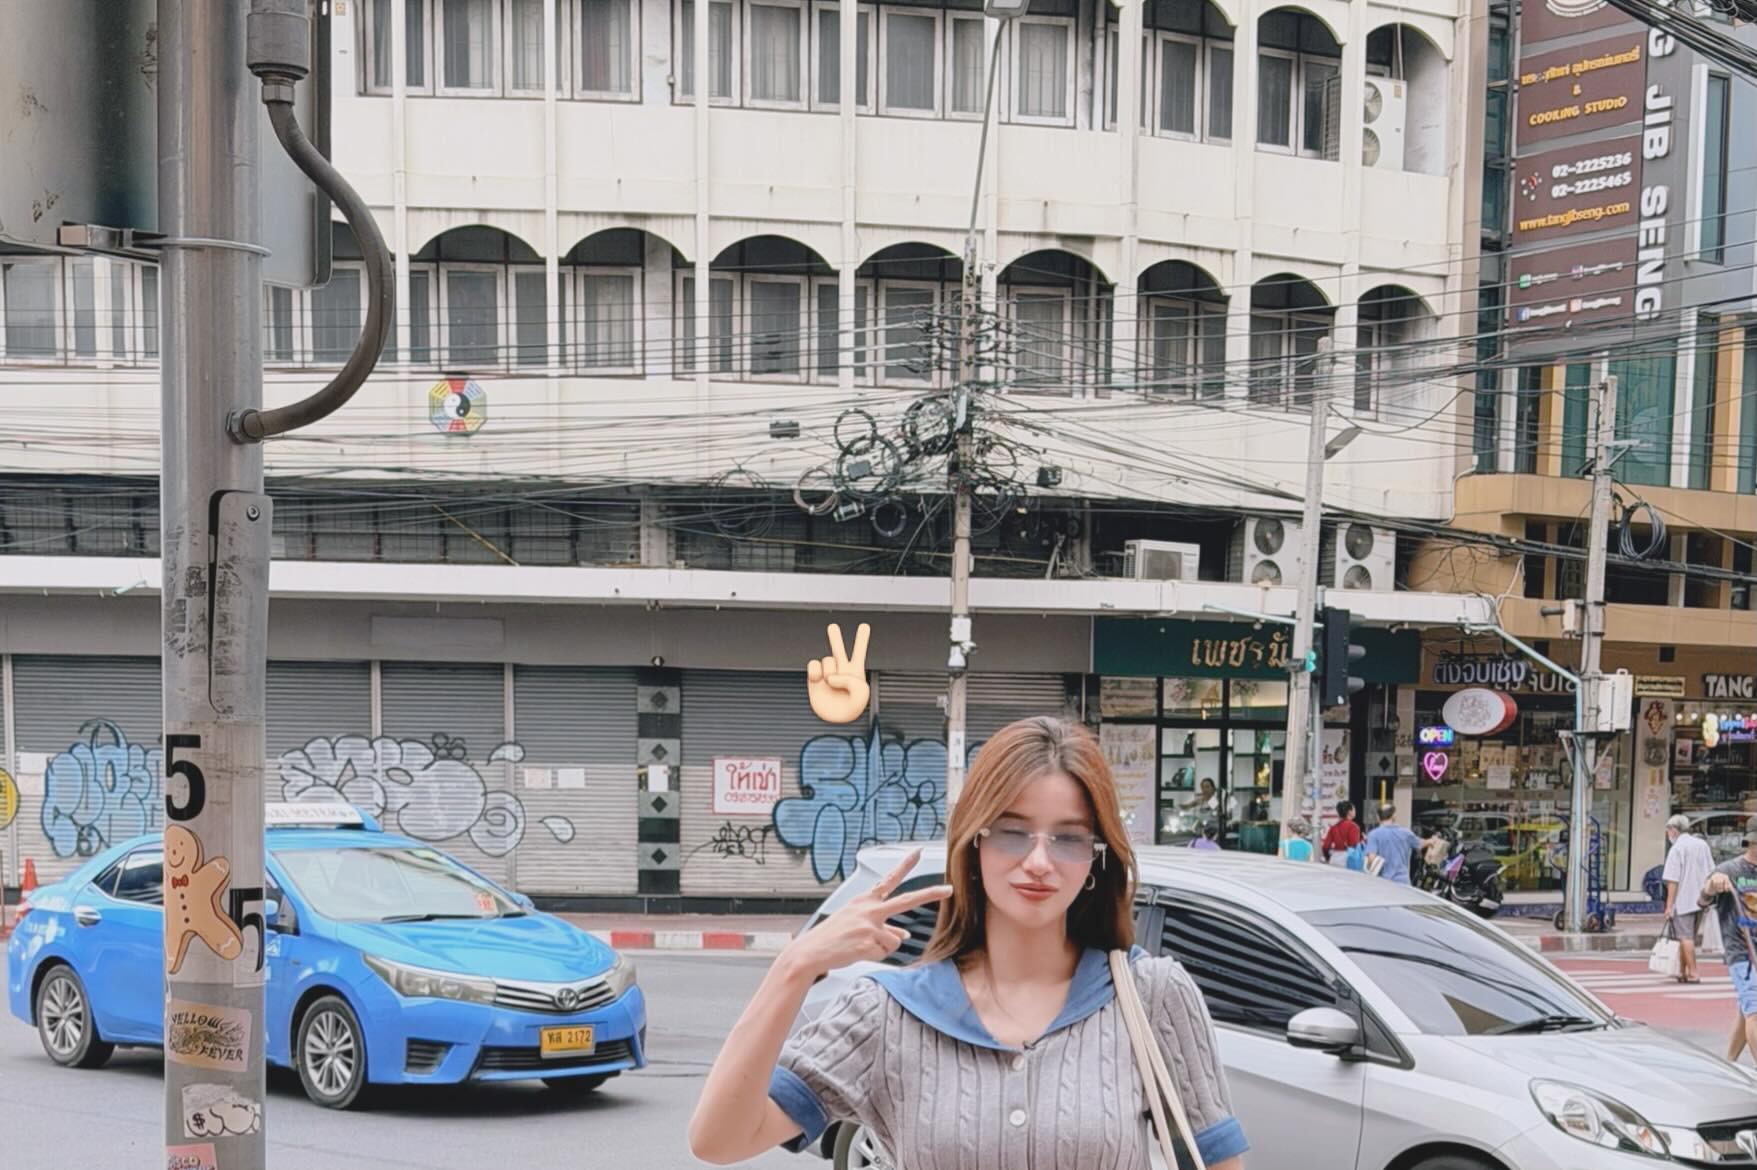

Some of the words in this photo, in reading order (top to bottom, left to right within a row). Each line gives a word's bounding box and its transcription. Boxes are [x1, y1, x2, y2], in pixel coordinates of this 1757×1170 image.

[1529, 105, 1580, 126] COOKING
[1584, 96, 1628, 114] STUDIO
[1644, 84, 1673, 160] JIB
[1552, 152, 1632, 178] 02-2225236
[1551, 171, 1632, 198] 02-2225465
[1635, 185, 1669, 320] SENG
[1705, 675, 1753, 698] TANG
[1420, 727, 1454, 743] OPEN
[166, 734, 205, 821] 5
[568, 1029, 591, 1044] 2172
